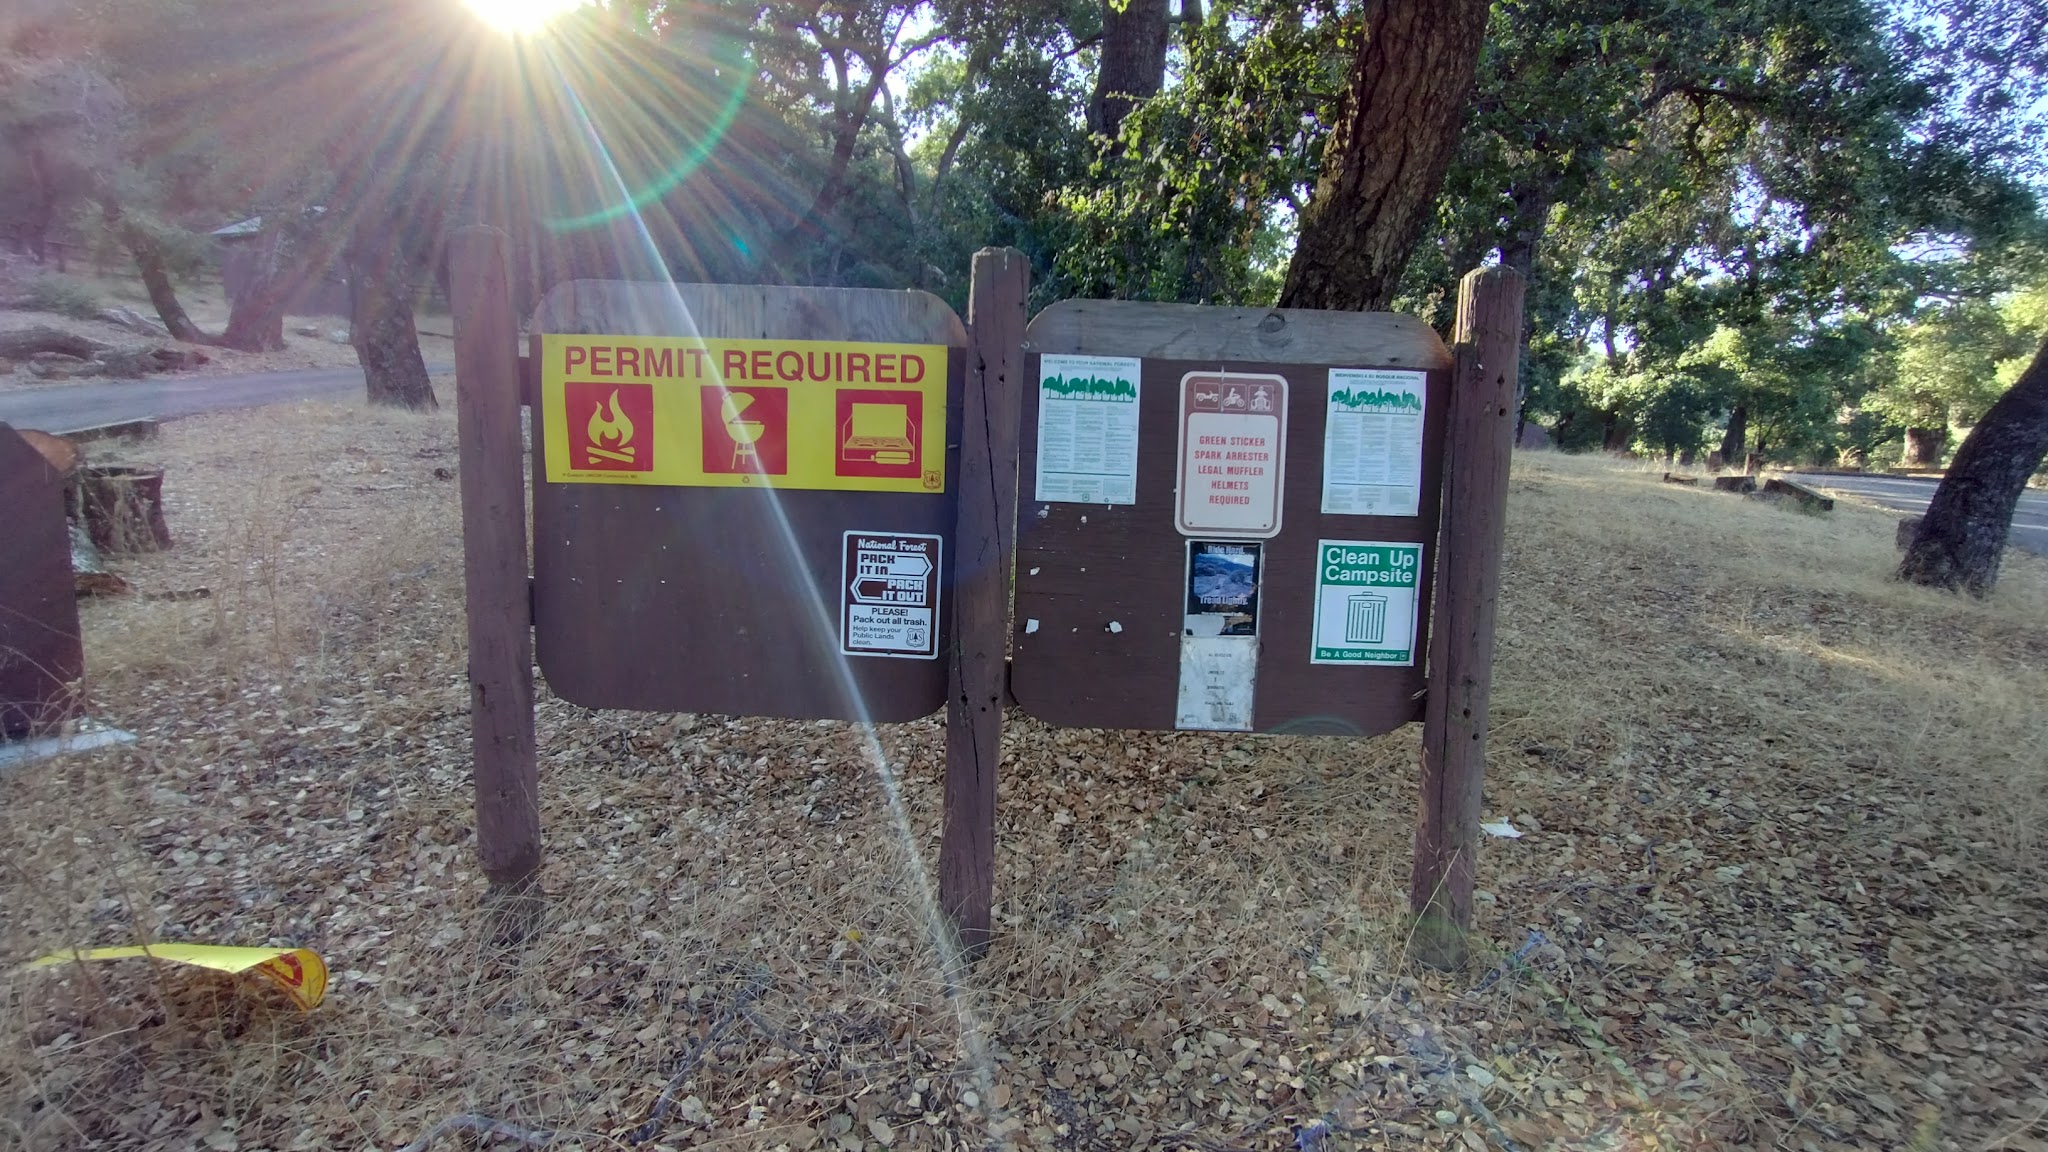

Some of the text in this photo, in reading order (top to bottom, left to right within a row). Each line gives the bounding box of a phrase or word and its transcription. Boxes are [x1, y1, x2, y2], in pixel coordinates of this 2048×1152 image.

[565, 346, 925, 383] PERMIT REQUIRED
[1199, 436, 1265, 447] GREEN STICKER
[1194, 450, 1269, 462] SPARK ARRESTER
[1198, 465, 1264, 476] LEGAL MUFFLER
[1211, 480, 1249, 490] HELMETS
[1209, 495, 1250, 505] REQUIRED
[858, 538, 927, 552] National Forest
[860, 553, 895, 564] PACK
[1326, 547, 1414, 569] Clean Up
[860, 565, 872, 575] IT
[1325, 565, 1413, 585] Campsite
[887, 579, 923, 591] PACK
[882, 590, 923, 602] IT OUT
[872, 607, 908, 616] PLEASE!
[853, 615, 874, 624] Pack
[892, 617, 902, 625] all
[904, 618, 927, 626] trash.
[1334, 650, 1340, 658] A
[1364, 651, 1398, 660] Neighbor
